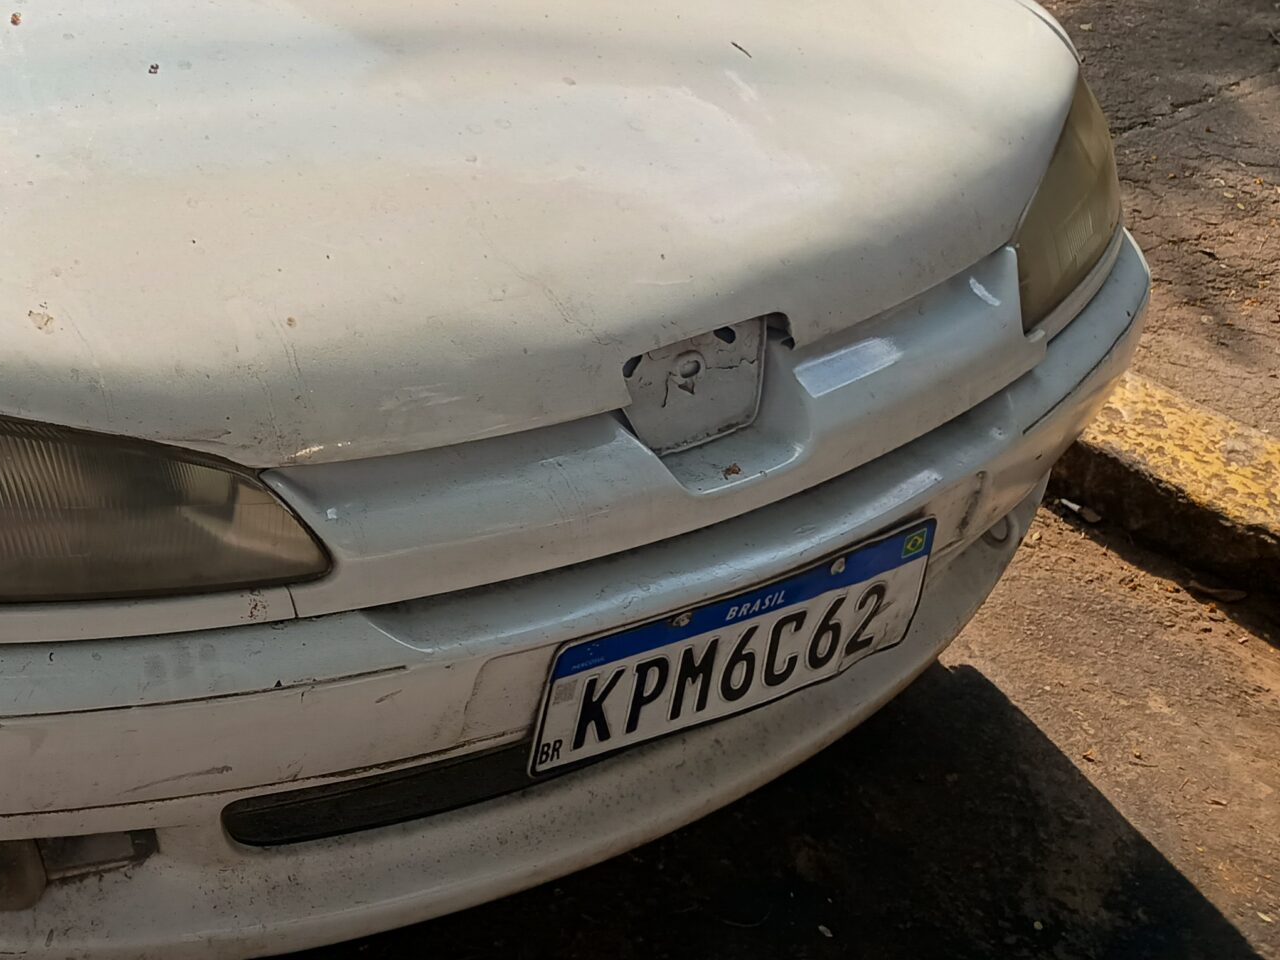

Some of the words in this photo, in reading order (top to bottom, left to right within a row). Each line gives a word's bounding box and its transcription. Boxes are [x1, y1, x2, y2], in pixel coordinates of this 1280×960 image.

[725, 590, 785, 621] BRASIL
[571, 582, 887, 751] KPM6C62
[538, 739, 563, 765] BR
